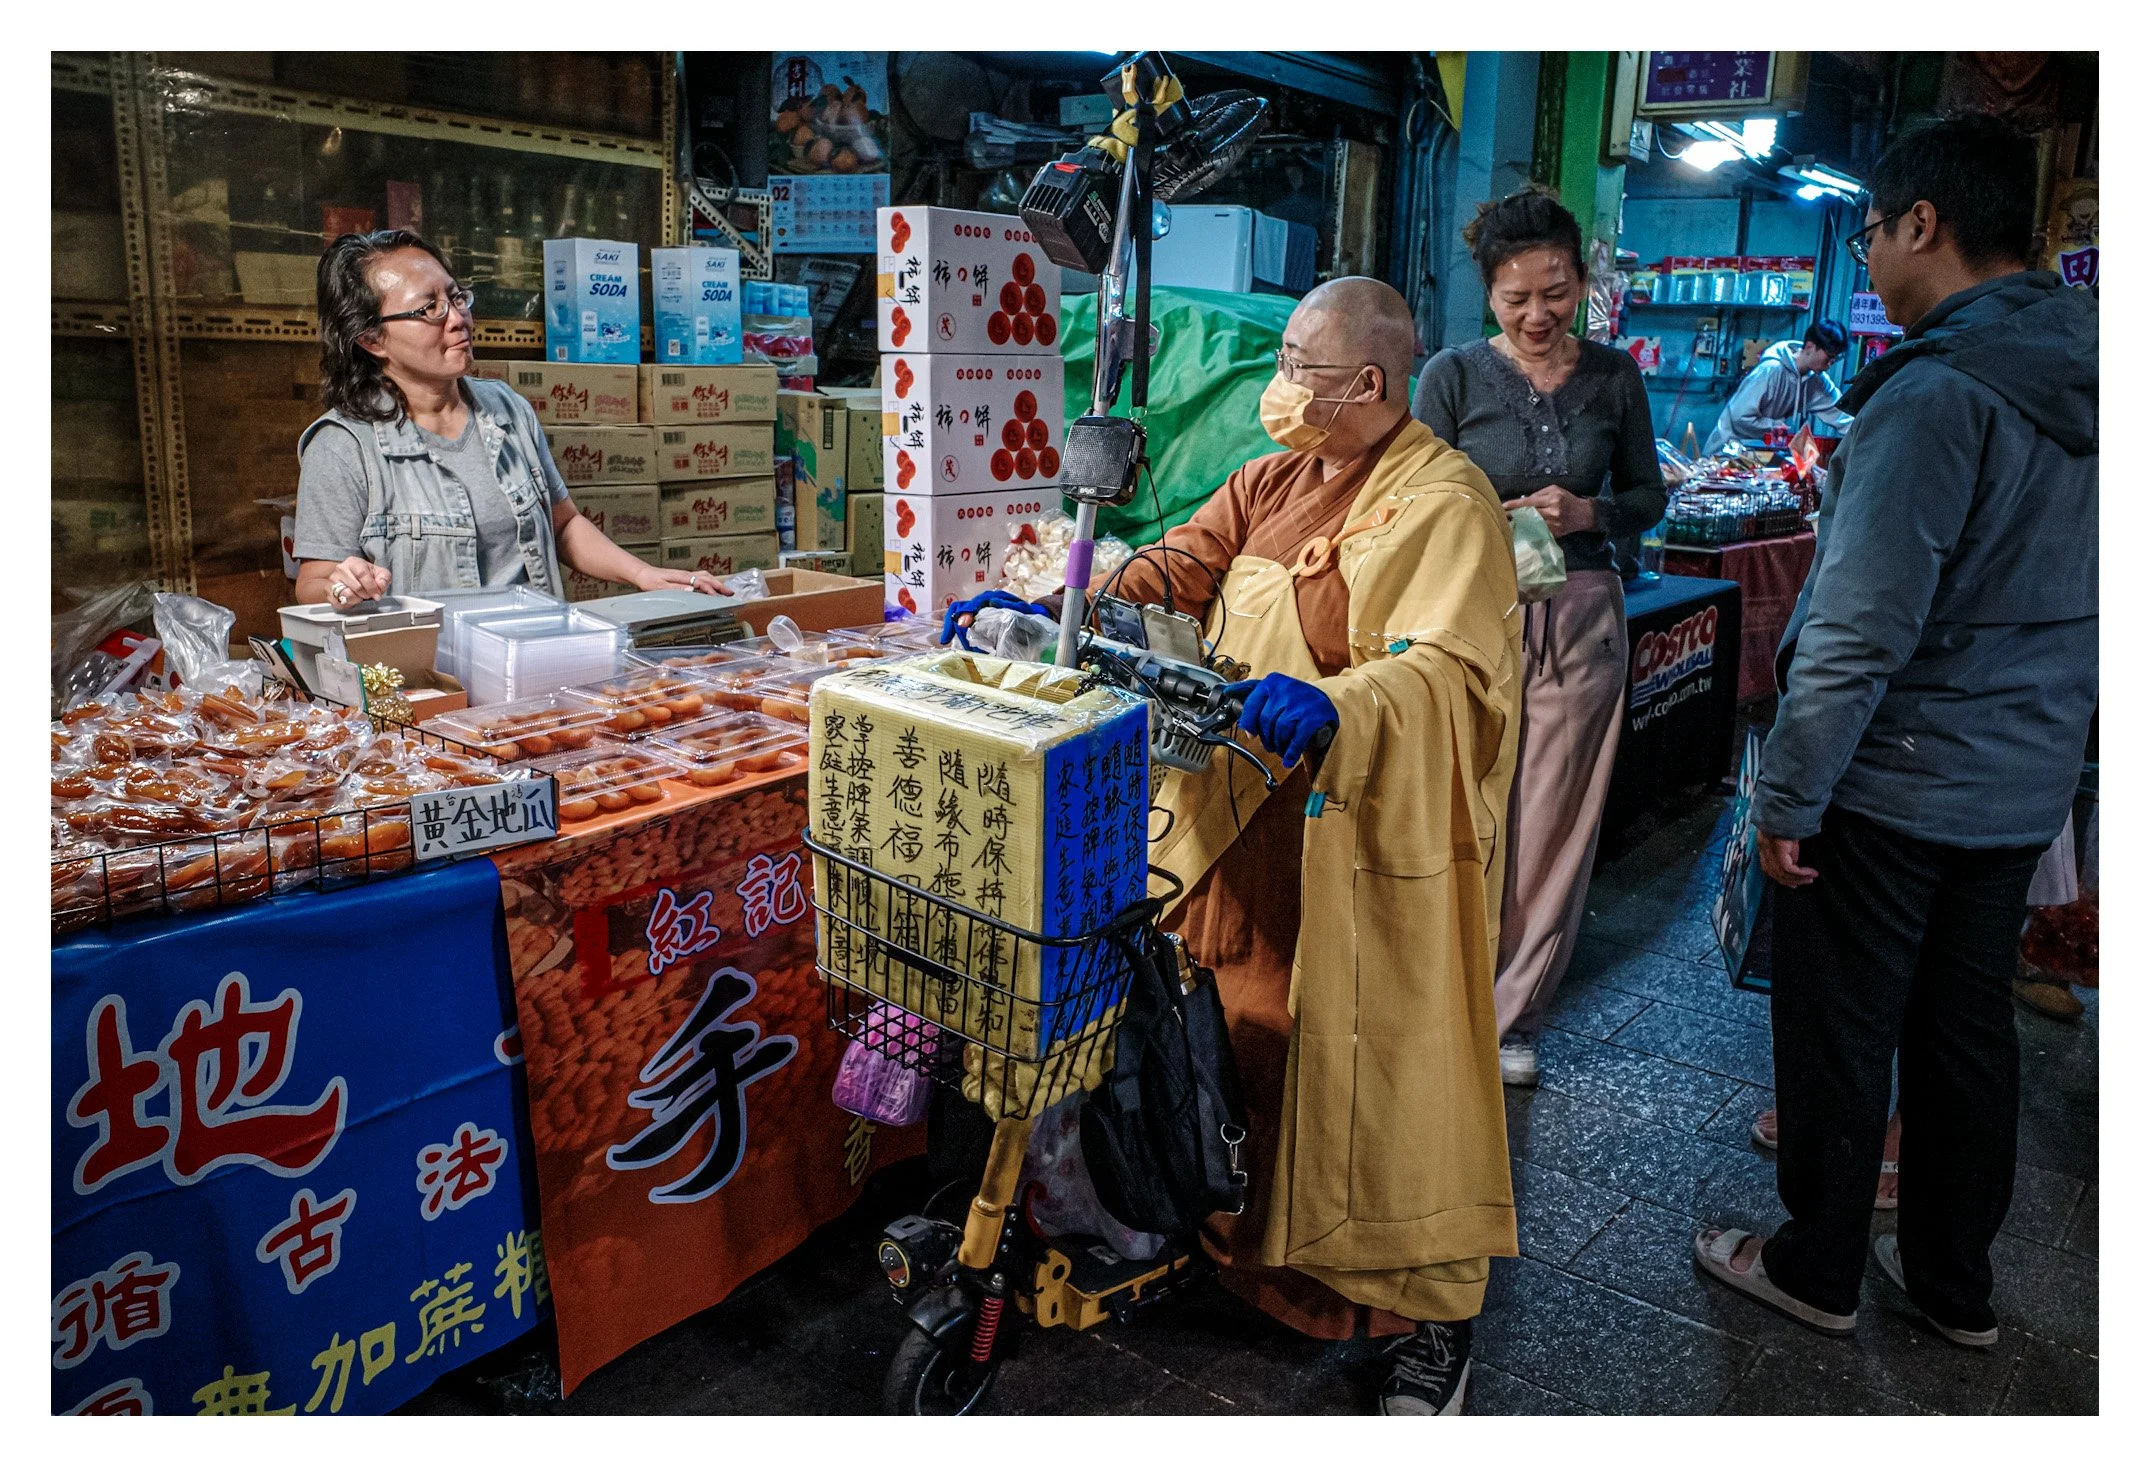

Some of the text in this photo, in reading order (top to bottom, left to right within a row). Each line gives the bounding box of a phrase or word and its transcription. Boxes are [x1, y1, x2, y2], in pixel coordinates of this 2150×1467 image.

[1730, 51, 1753, 98] 業社
[772, 186, 790, 201] 02
[594, 251, 621, 262] SAKI
[705, 259, 726, 269] SAKI
[589, 273, 622, 283] CREAM
[702, 280, 729, 289] CREAM
[589, 283, 628, 297] SODA
[702, 289, 732, 301] SODA
[1850, 312, 1890, 326] 0931395
[1632, 605, 1718, 685] COSTCO
[645, 851, 807, 975] 紅記
[67, 971, 348, 1195] 地
[606, 966, 800, 1205] 手
